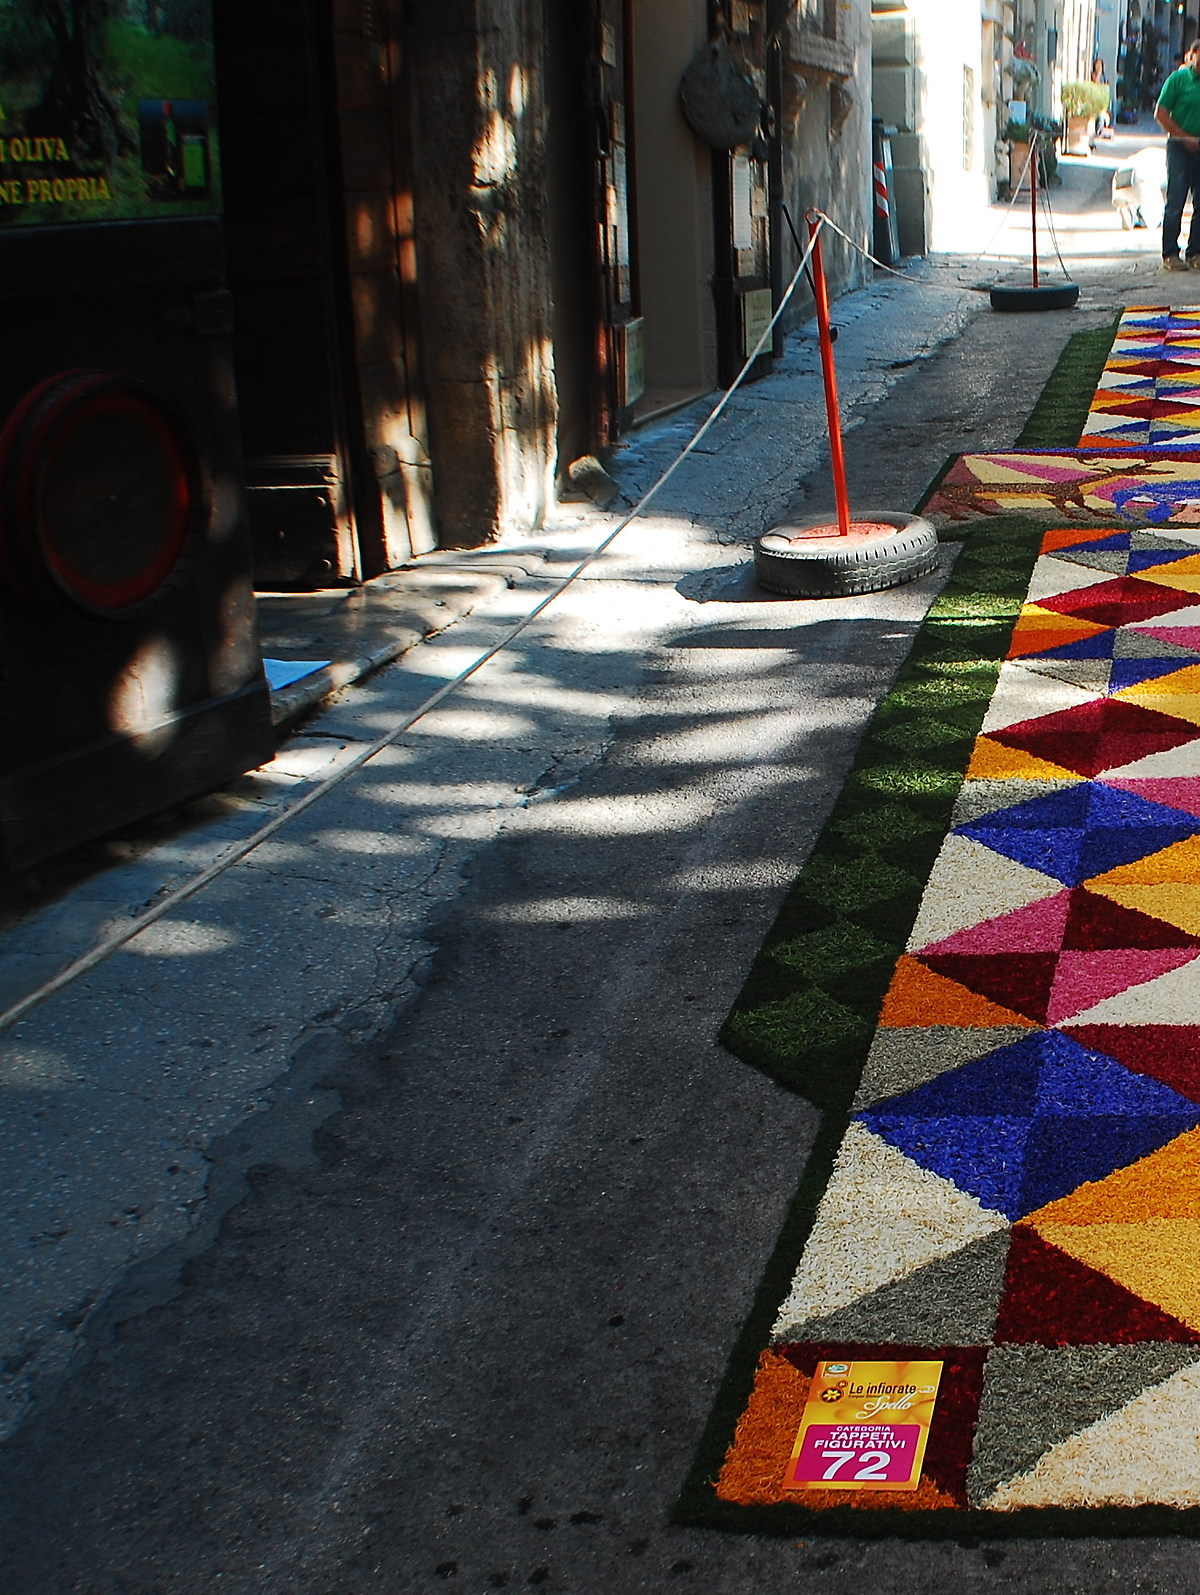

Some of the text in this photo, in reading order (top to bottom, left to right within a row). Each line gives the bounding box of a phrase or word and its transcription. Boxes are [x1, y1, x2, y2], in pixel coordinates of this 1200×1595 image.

[9, 136, 70, 161] OLIVA
[26, 177, 112, 203] PROPRIA
[849, 1382, 916, 1394] Le infiorate
[856, 1386, 935, 1419] Spello
[814, 1440, 906, 1449] FIGURATIVI
[830, 1432, 895, 1440] TAPPETI
[821, 1451, 891, 1480] 72
